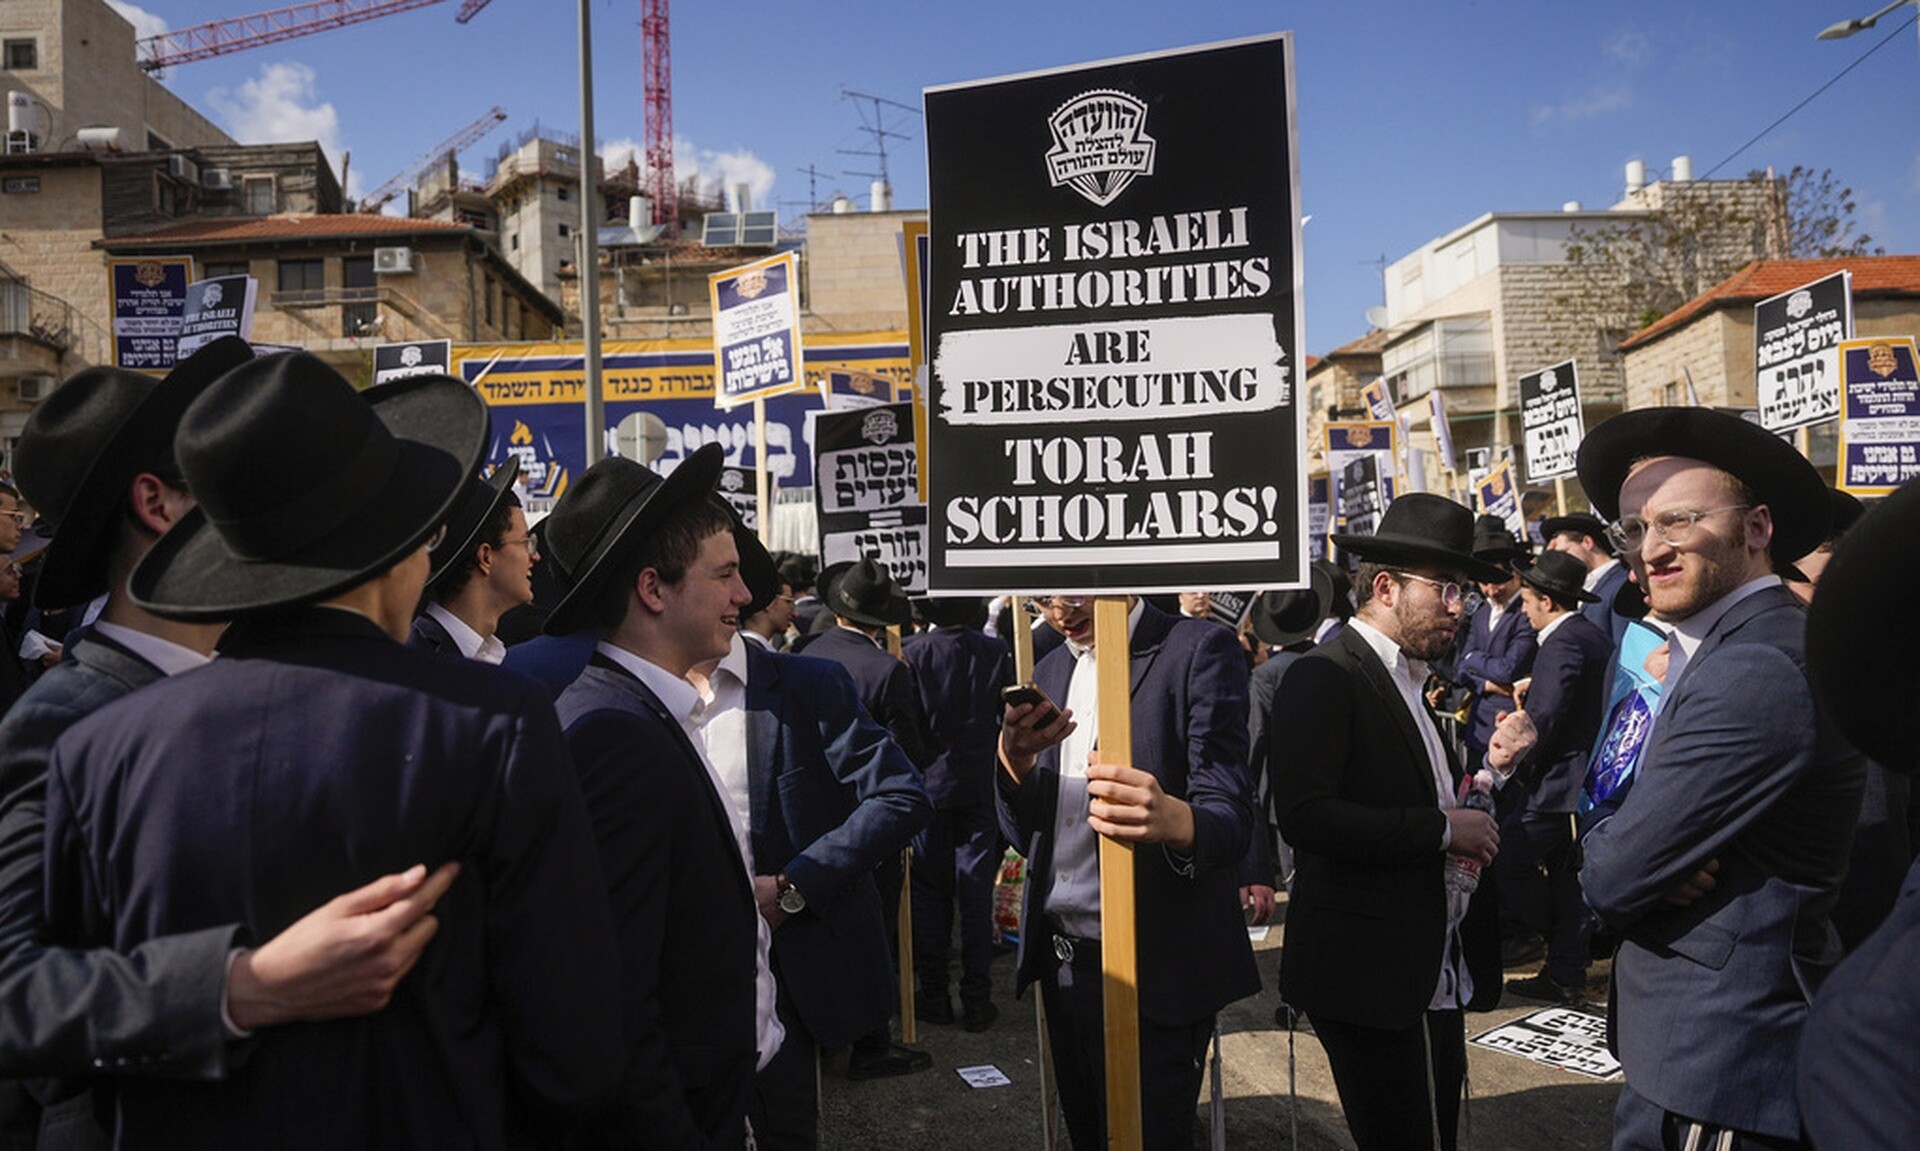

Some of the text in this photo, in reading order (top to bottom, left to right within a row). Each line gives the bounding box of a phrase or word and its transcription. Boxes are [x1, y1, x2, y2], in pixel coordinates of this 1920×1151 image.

[1059, 100, 1137, 138] הוועדה
[1075, 132, 1125, 153] להצלת
[1056, 148, 1145, 175] עולם התורה
[956, 206, 1250, 268] THE ISRAELI
[948, 256, 1272, 316] AUTHORITIES
[182, 319, 239, 335] AUTHORITIES
[201, 308, 236, 320] ISRAELI
[1064, 329, 1151, 366] ARE
[483, 379, 542, 399] השמד
[549, 380, 586, 396] ירת
[608, 377, 653, 394] כנגד
[961, 367, 1259, 414] PERSECUTING
[1775, 358, 1825, 402] יהרג
[1004, 431, 1214, 485] TORAH
[945, 485, 1279, 544] SCHOLARS!
[854, 530, 921, 560] חורבן
[1210, 592, 1245, 613] ARS!
